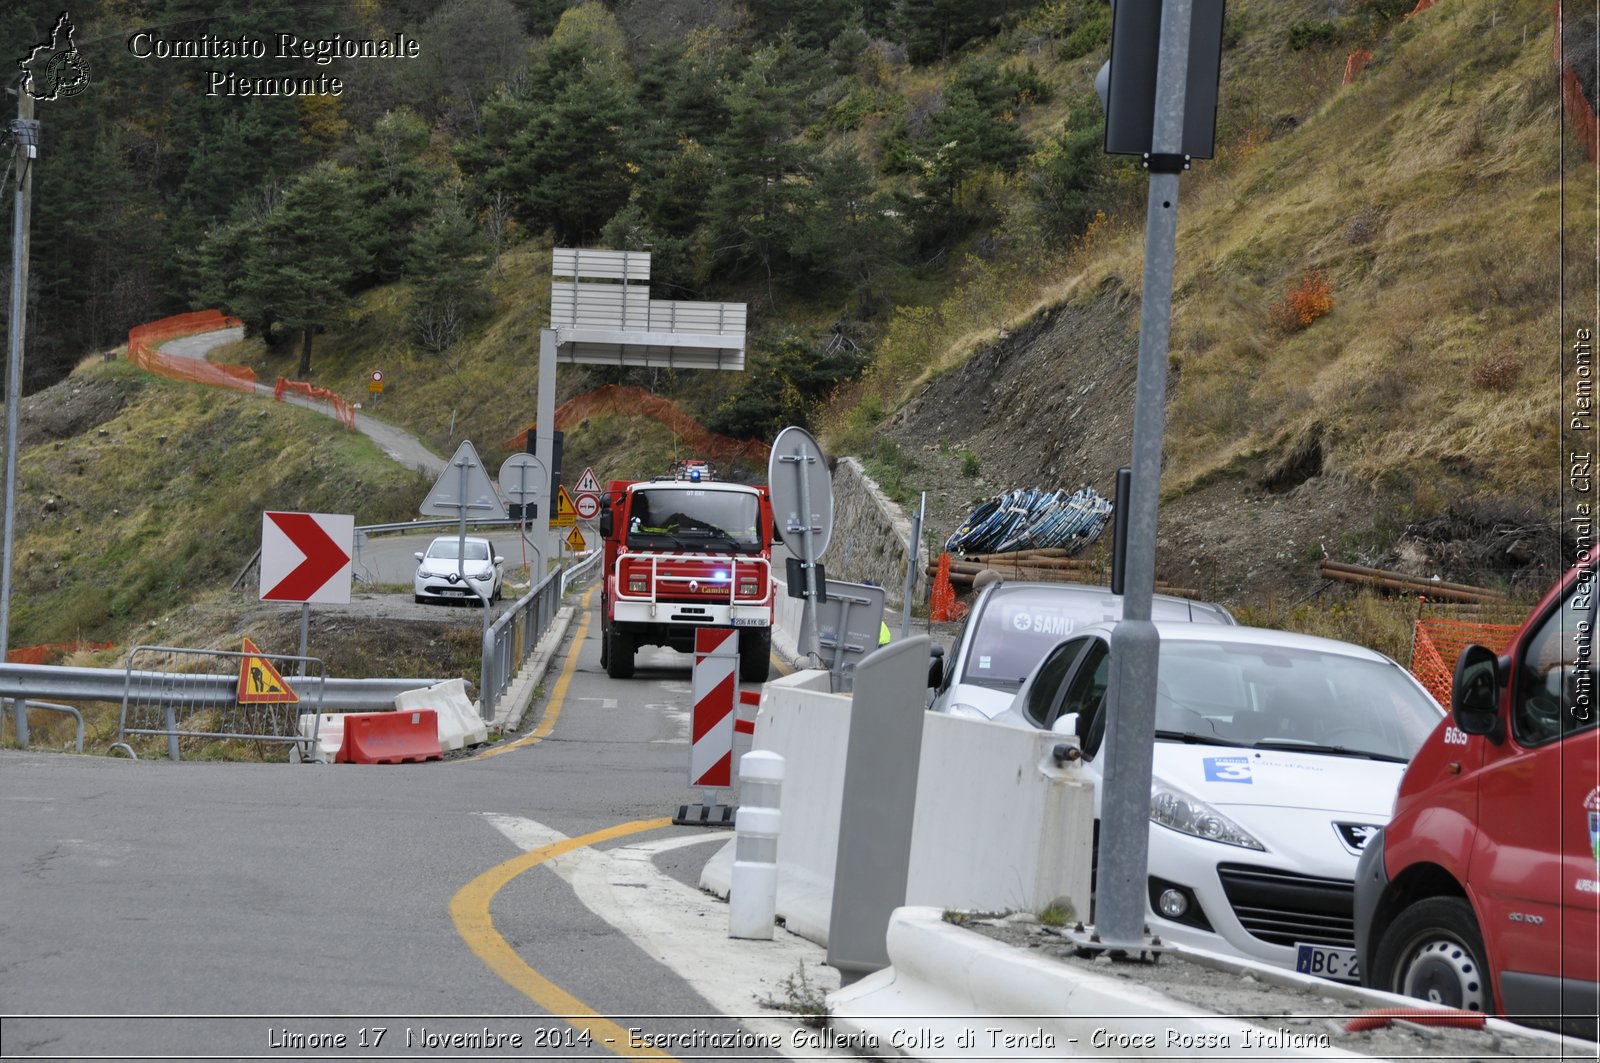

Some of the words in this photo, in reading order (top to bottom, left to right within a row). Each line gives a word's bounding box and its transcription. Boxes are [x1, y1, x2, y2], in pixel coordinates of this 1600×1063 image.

[701, 586, 729, 594] Camiva
[1034, 615, 1074, 636] SAMU
[1444, 726, 1468, 745] B635
[1215, 763, 1252, 779] 3
[1312, 950, 1360, 977] BC-2
